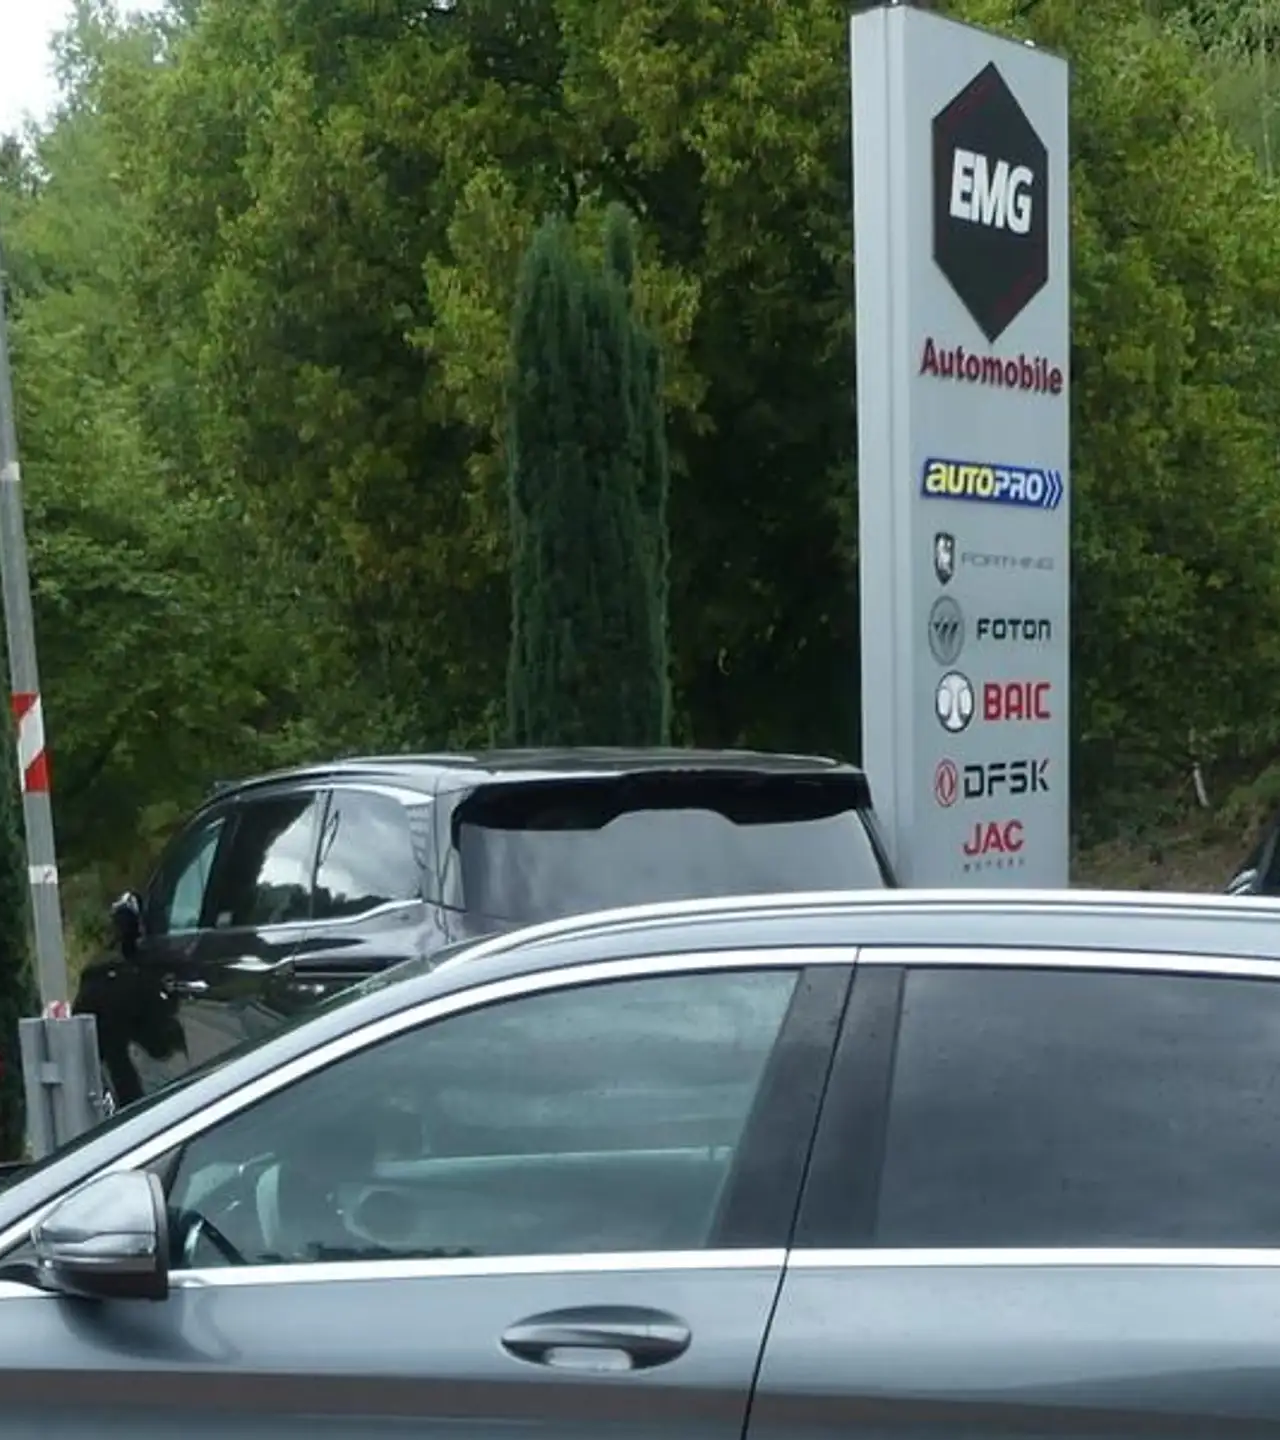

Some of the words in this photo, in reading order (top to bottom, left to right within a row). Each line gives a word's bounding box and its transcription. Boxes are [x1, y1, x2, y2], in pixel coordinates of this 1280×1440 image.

[949, 147, 1034, 235] EMG
[920, 336, 1064, 395] Automobile
[983, 681, 1052, 721] BAIC
[963, 757, 1050, 799] DFSK
[963, 818, 1025, 857] JAC
